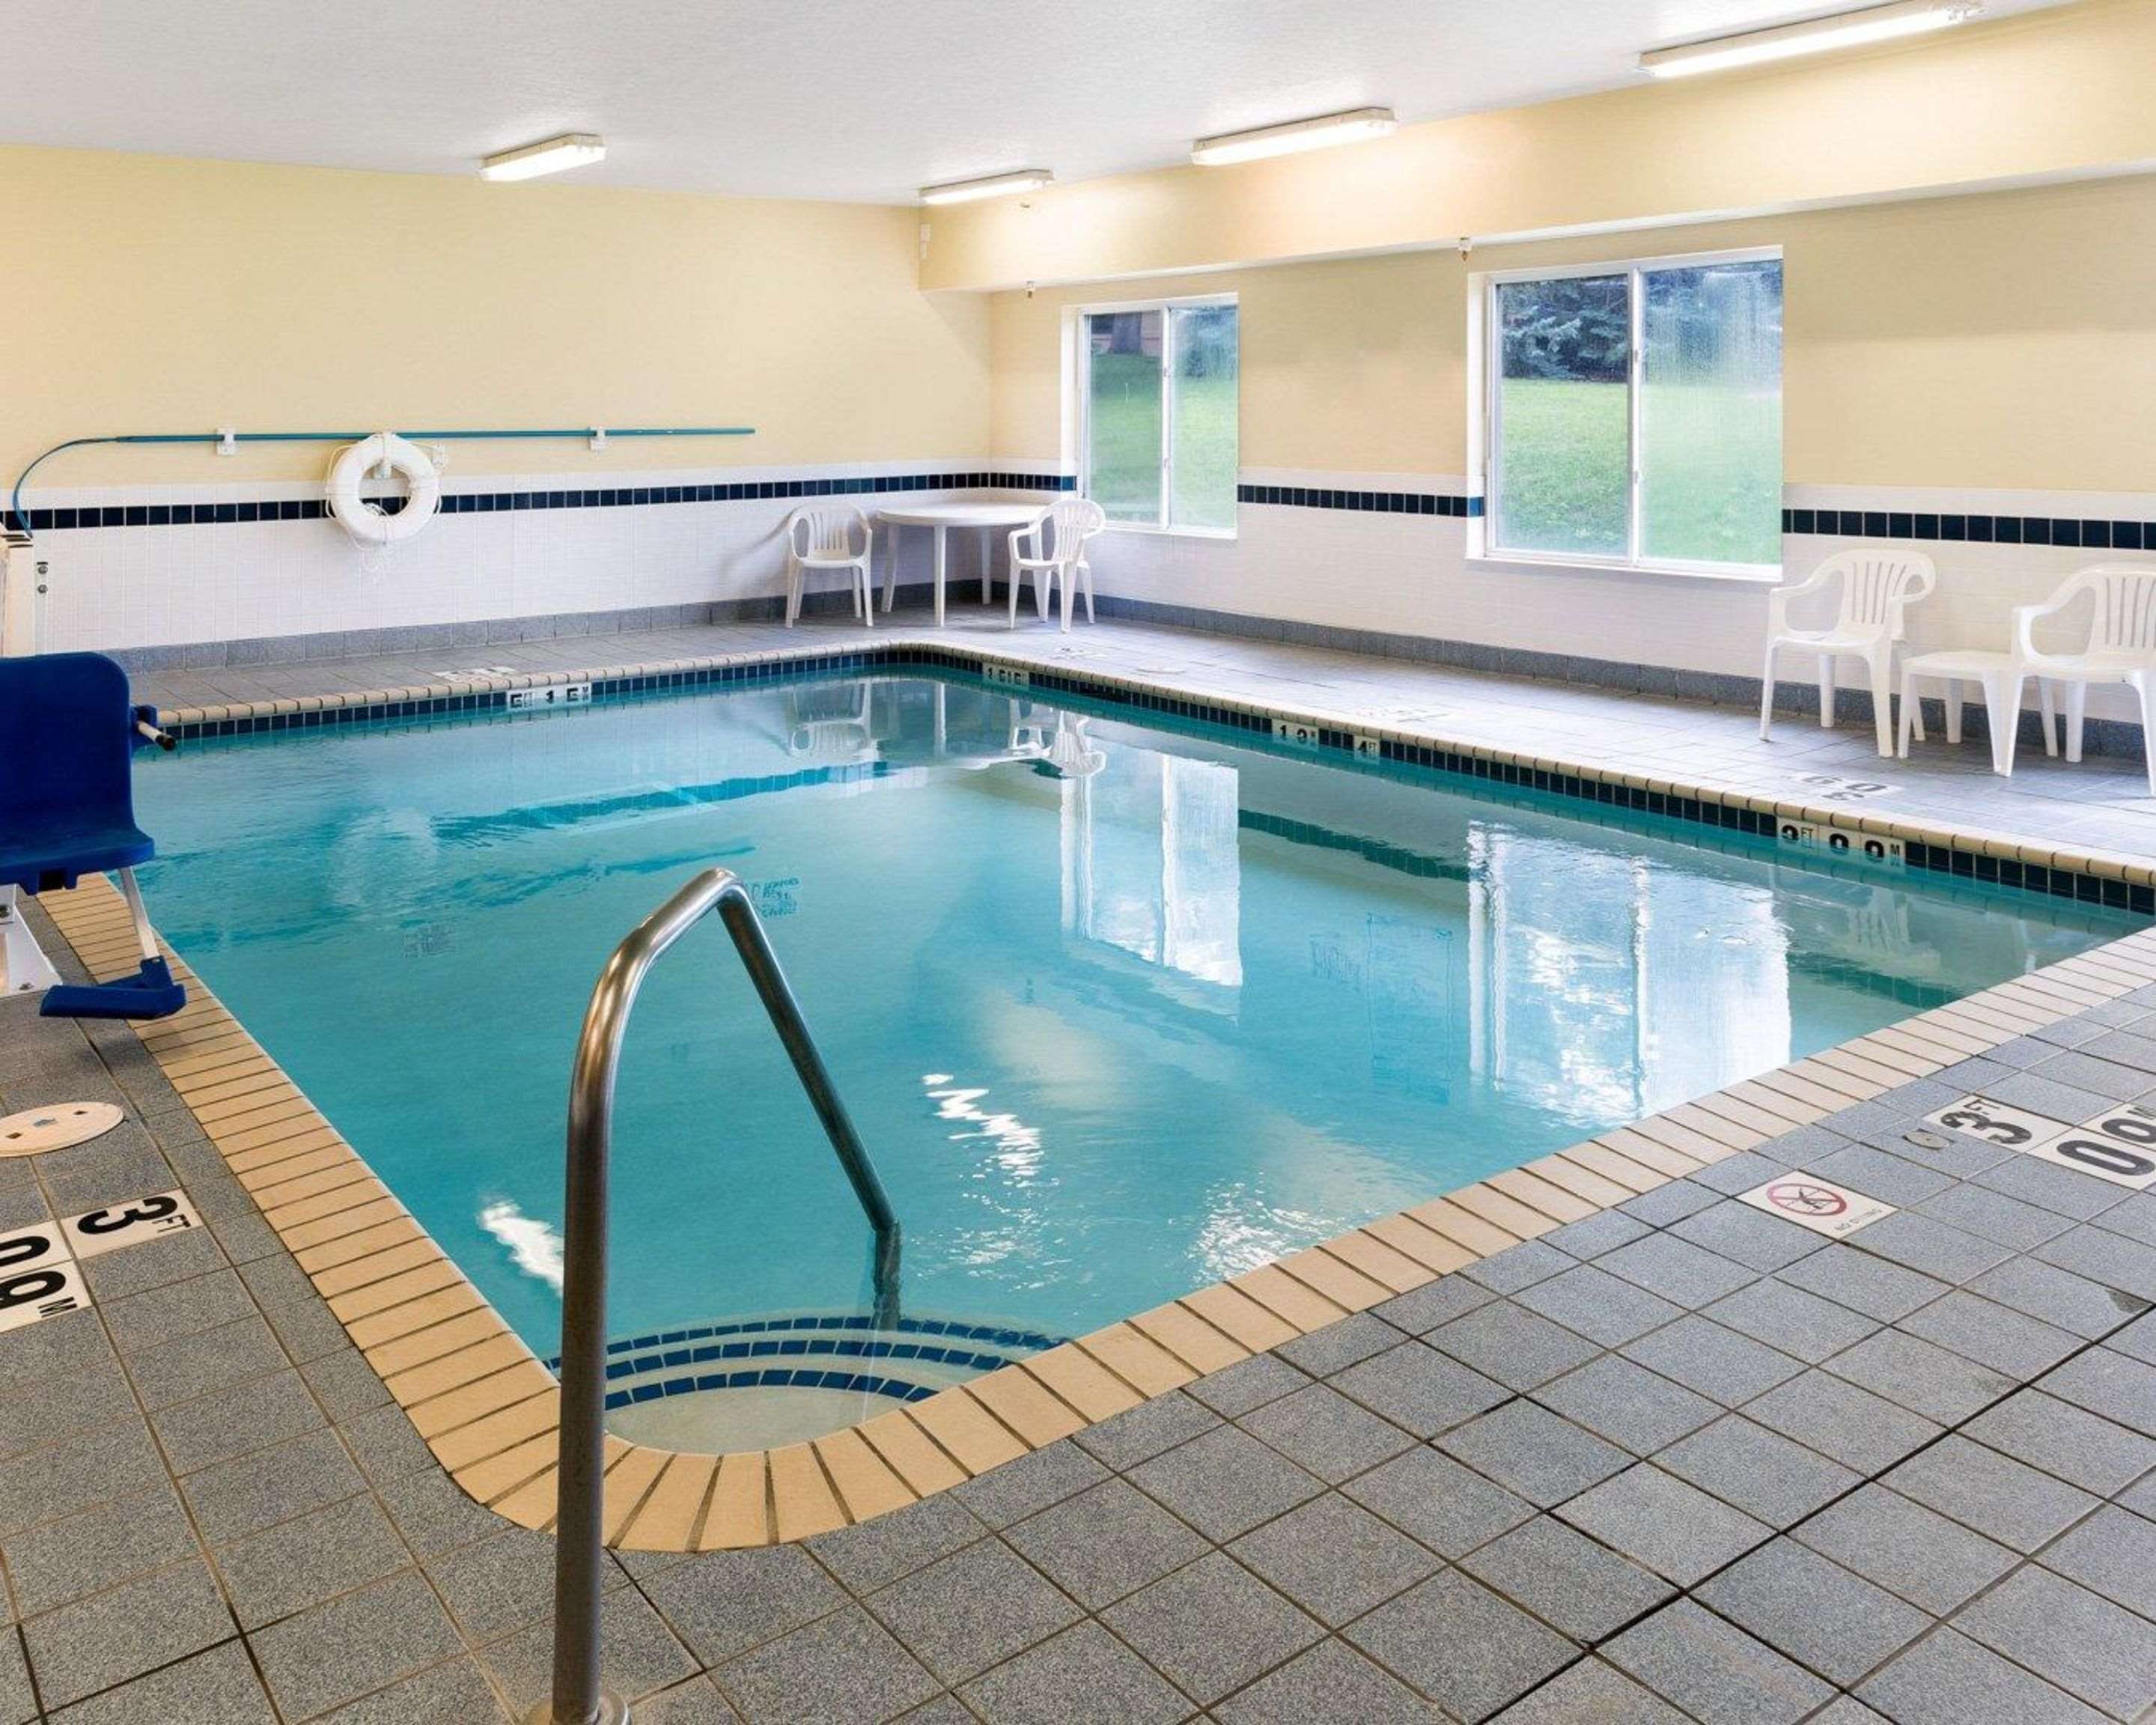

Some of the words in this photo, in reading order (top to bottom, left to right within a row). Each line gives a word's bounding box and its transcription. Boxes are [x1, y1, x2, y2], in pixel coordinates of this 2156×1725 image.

[1940, 1111, 2032, 1145] 3
[77, 1196, 178, 1235] 3
[152, 1214, 192, 1233] FT
